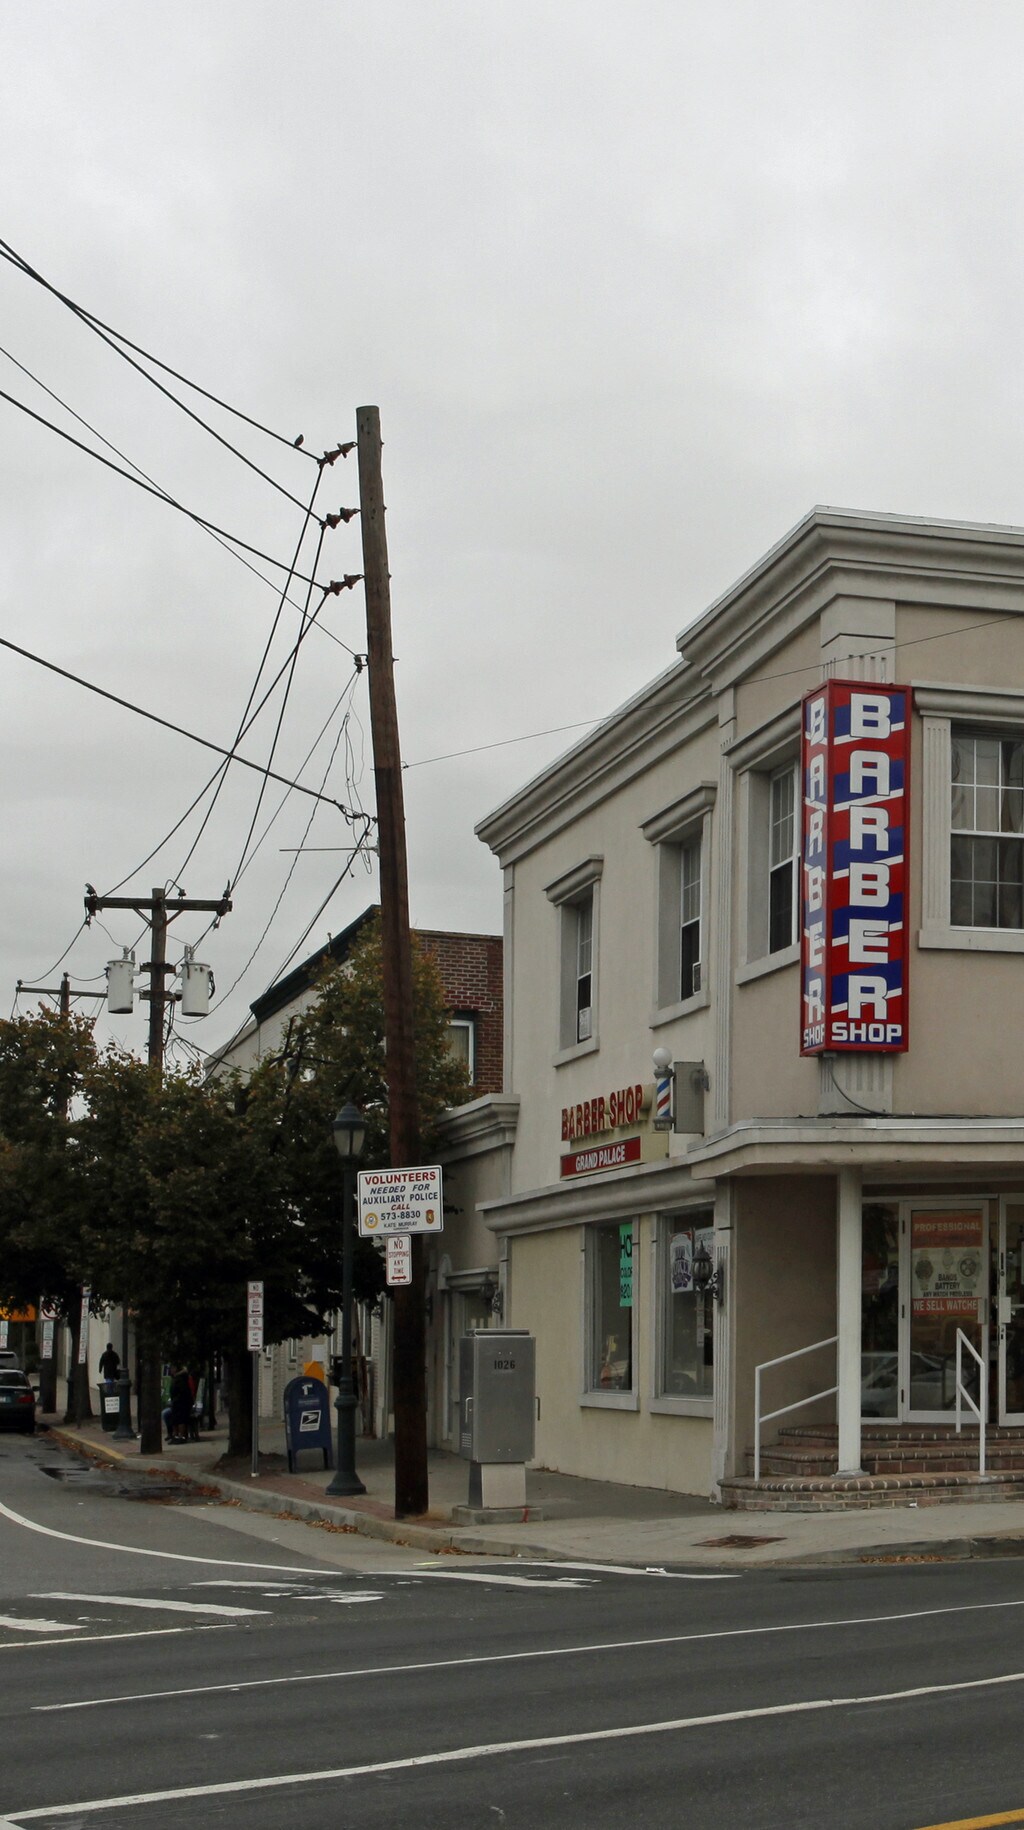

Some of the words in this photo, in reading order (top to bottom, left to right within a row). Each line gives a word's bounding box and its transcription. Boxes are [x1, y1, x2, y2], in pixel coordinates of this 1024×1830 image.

[808, 697, 825, 1025] BARBER
[848, 693, 892, 1020] BARBER
[831, 1022, 902, 1044] SHOP
[562, 1097, 605, 1141] BARBER
[609, 1084, 642, 1128] SHOP
[576, 1152, 598, 1172] GRAND
[598, 1145, 626, 1166] PALACE
[365, 1171, 436, 1185] VOLUNTEERS
[370, 1185, 406, 1195] NEEDED
[412, 1183, 430, 1191] FOR
[362, 1195, 406, 1205] AUXILIARY
[410, 1192, 438, 1202] POLICE
[381, 1210, 420, 1220] 573-8830
[914, 1222, 981, 1232] PROFESSIONAL
[394, 1240, 403, 1249] NO
[388, 1250, 409, 1258] STOPPING
[935, 1282, 960, 1290] BATTERY
[913, 1301, 924, 1311] WE
[926, 1300, 944, 1310] SELL
[494, 1360, 516, 1370] 1026
